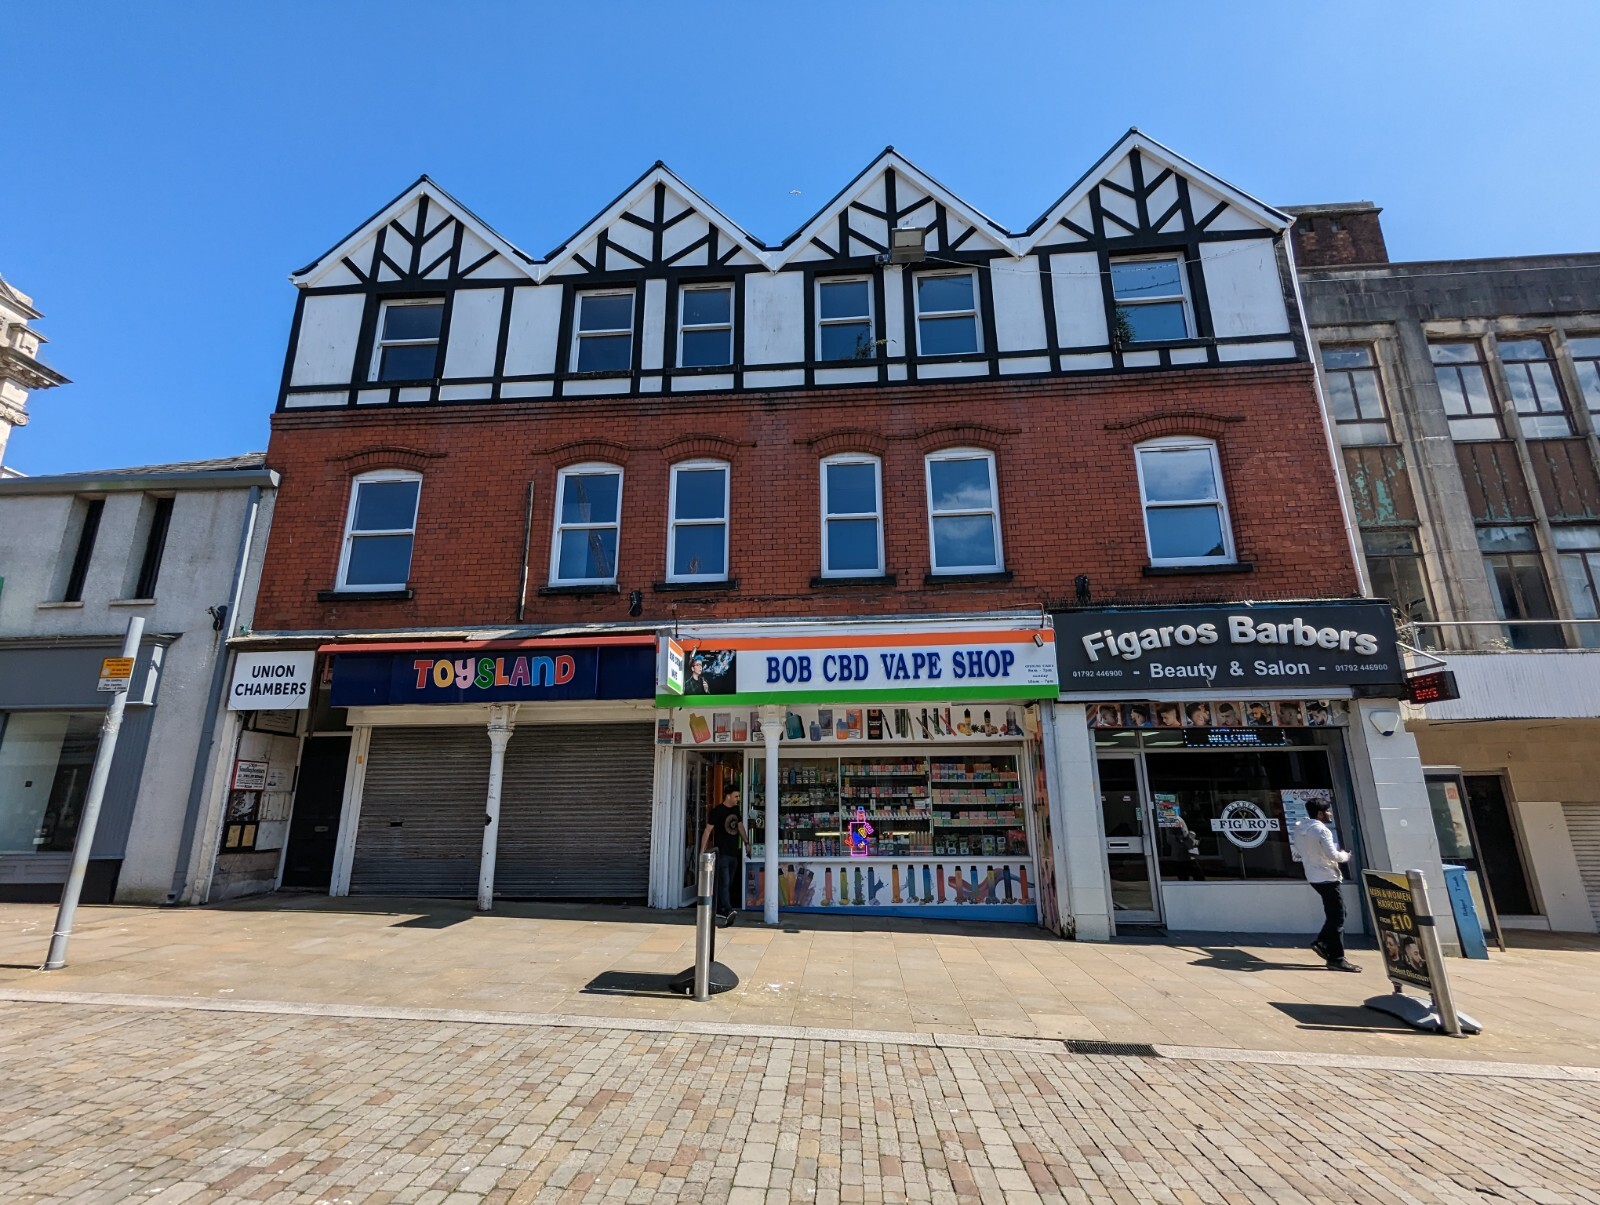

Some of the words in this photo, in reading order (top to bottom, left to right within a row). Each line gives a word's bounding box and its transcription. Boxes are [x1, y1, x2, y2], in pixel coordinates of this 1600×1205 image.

[1081, 622, 1219, 662] Figaros
[1227, 615, 1378, 656] Barbers
[251, 664, 296, 678] UNION
[766, 656, 812, 683] BOB
[822, 654, 869, 682] CBD
[880, 652, 942, 681] VAPE
[952, 649, 1015, 679] SHOP
[1149, 662, 1218, 681] Beauty
[1229, 660, 1245, 676] &
[1253, 660, 1310, 676] Salon
[1360, 663, 1388, 671] 446900
[234, 682, 307, 697] CHAMBERS
[1391, 913, 1413, 931] £10
